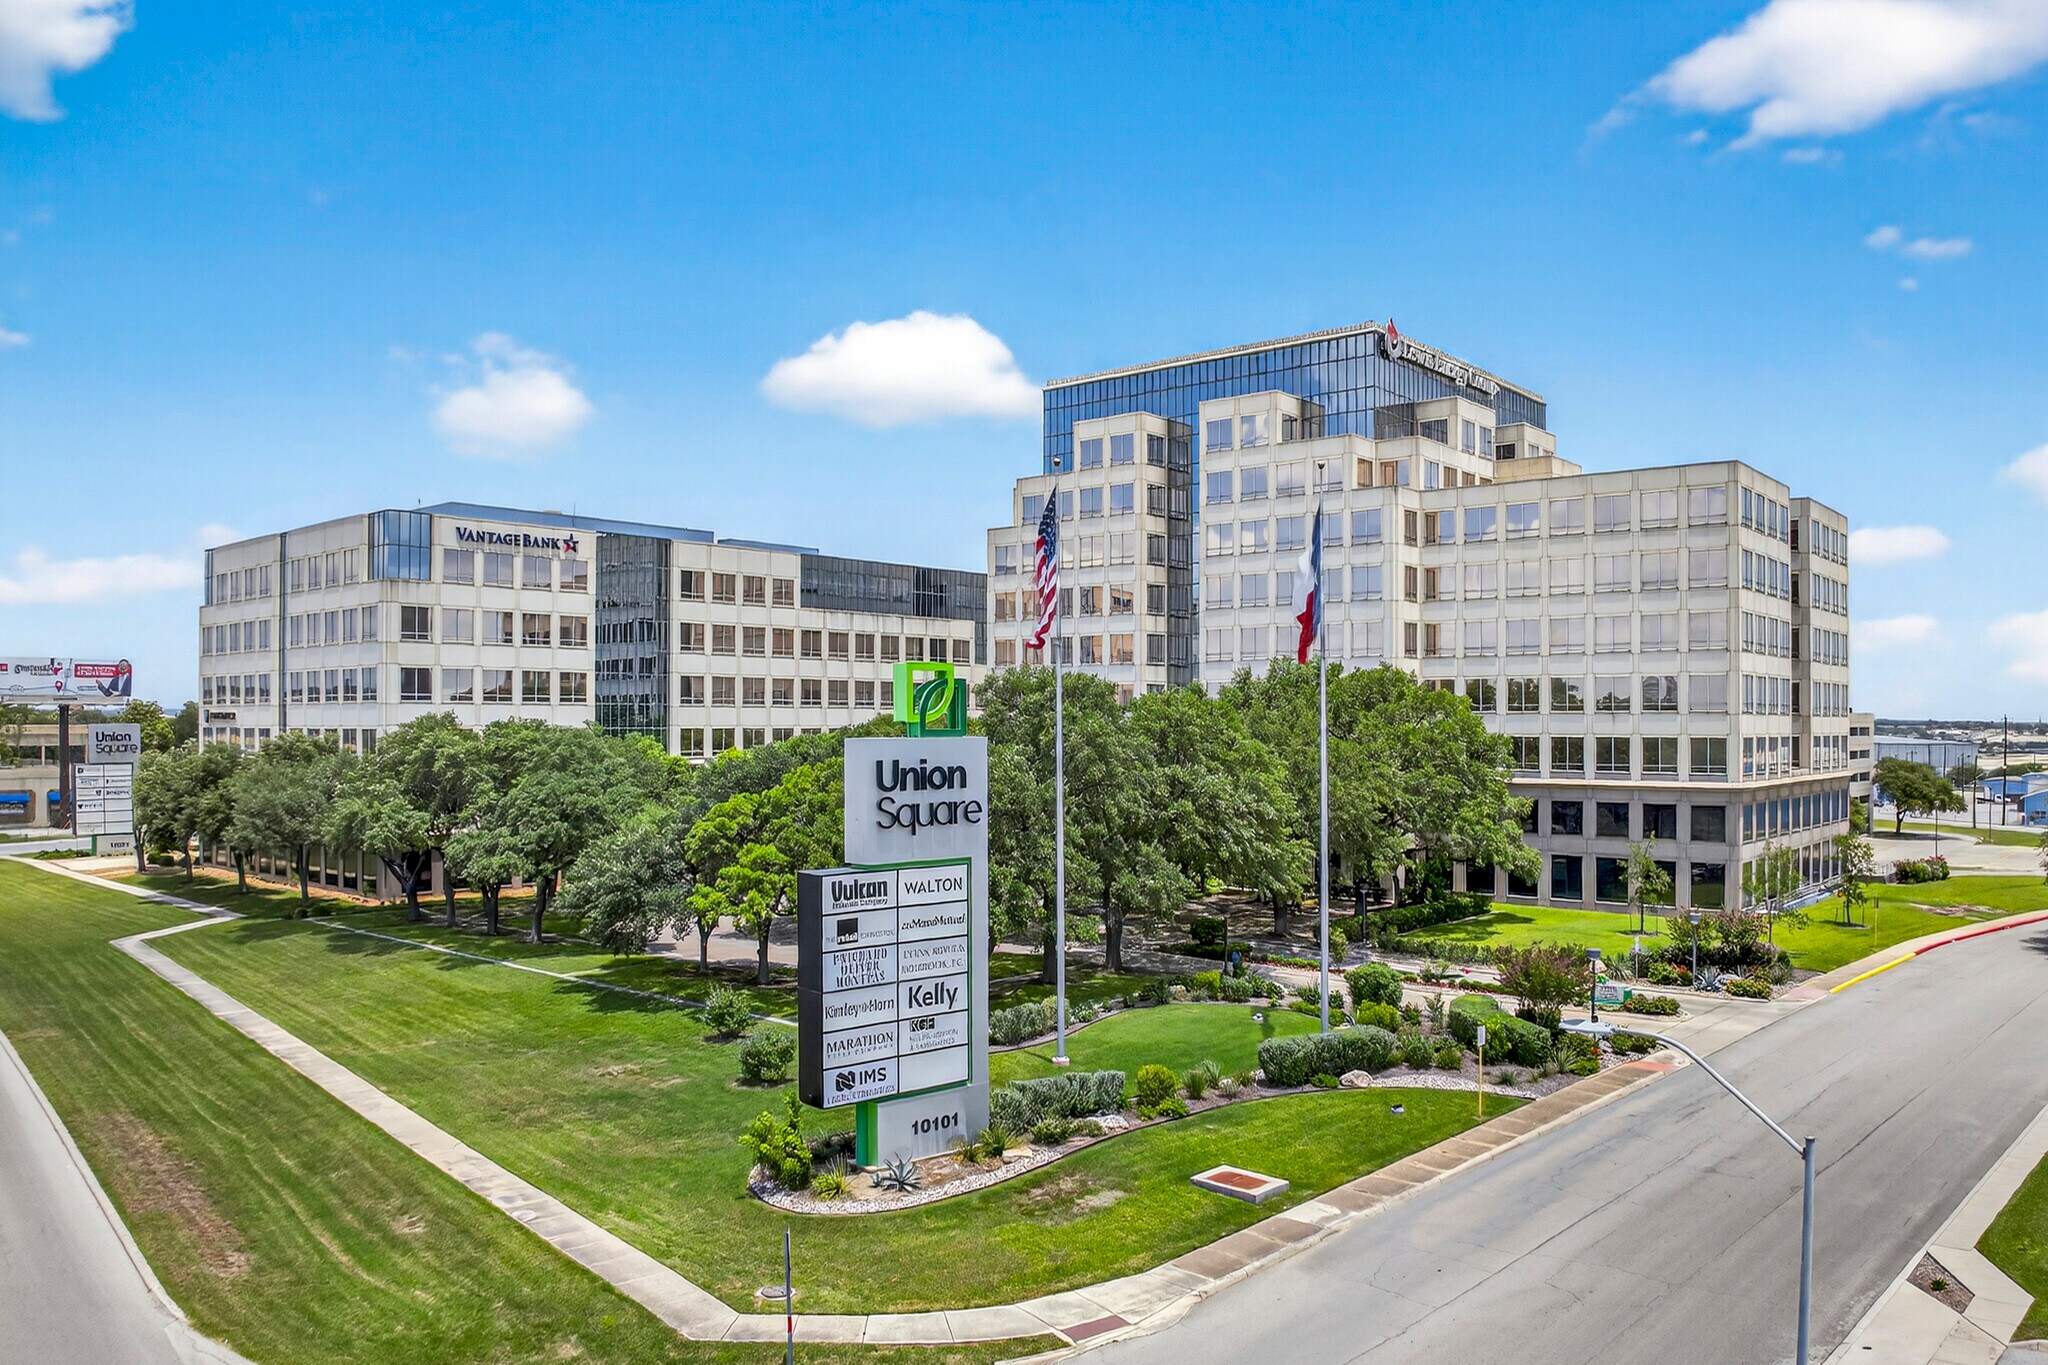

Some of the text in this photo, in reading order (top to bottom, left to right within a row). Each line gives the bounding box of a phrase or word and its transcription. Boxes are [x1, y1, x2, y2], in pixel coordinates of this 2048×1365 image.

[96, 731, 132, 742] Union
[95, 743, 138, 755] Square
[875, 758, 967, 793] Union
[876, 796, 983, 836] Square
[831, 879, 888, 902] Vulcan
[904, 876, 963, 895] WALTON
[908, 981, 959, 1010] Kelly
[826, 1031, 894, 1054] MARATHON
[859, 1067, 887, 1086] IMS
[911, 1112, 959, 1136] 10101
